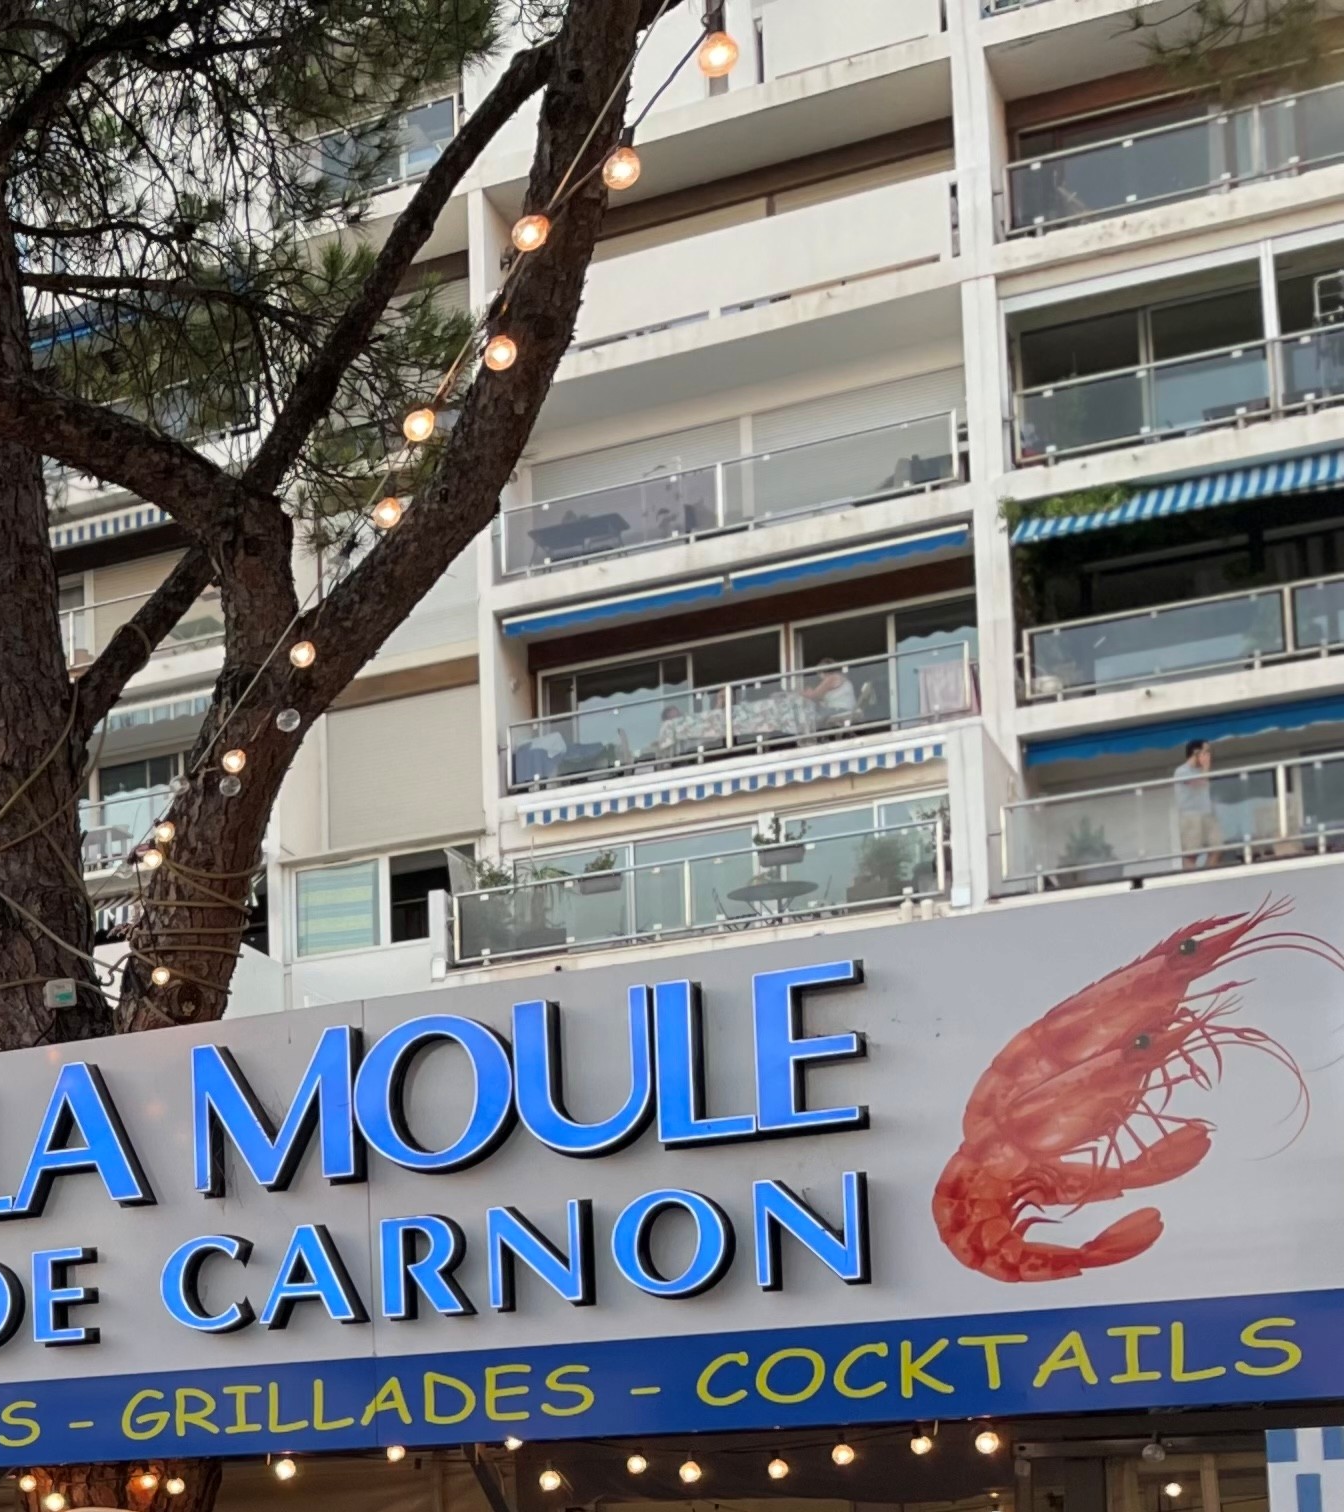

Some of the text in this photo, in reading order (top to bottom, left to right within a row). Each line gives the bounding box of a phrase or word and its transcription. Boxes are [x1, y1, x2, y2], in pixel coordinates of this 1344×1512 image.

[190, 959, 861, 1194] MOULE
[159, 1171, 864, 1332] CARNON
[121, 1364, 596, 1442] GRILLADES
[696, 1315, 1305, 1407] COCKTAILS
